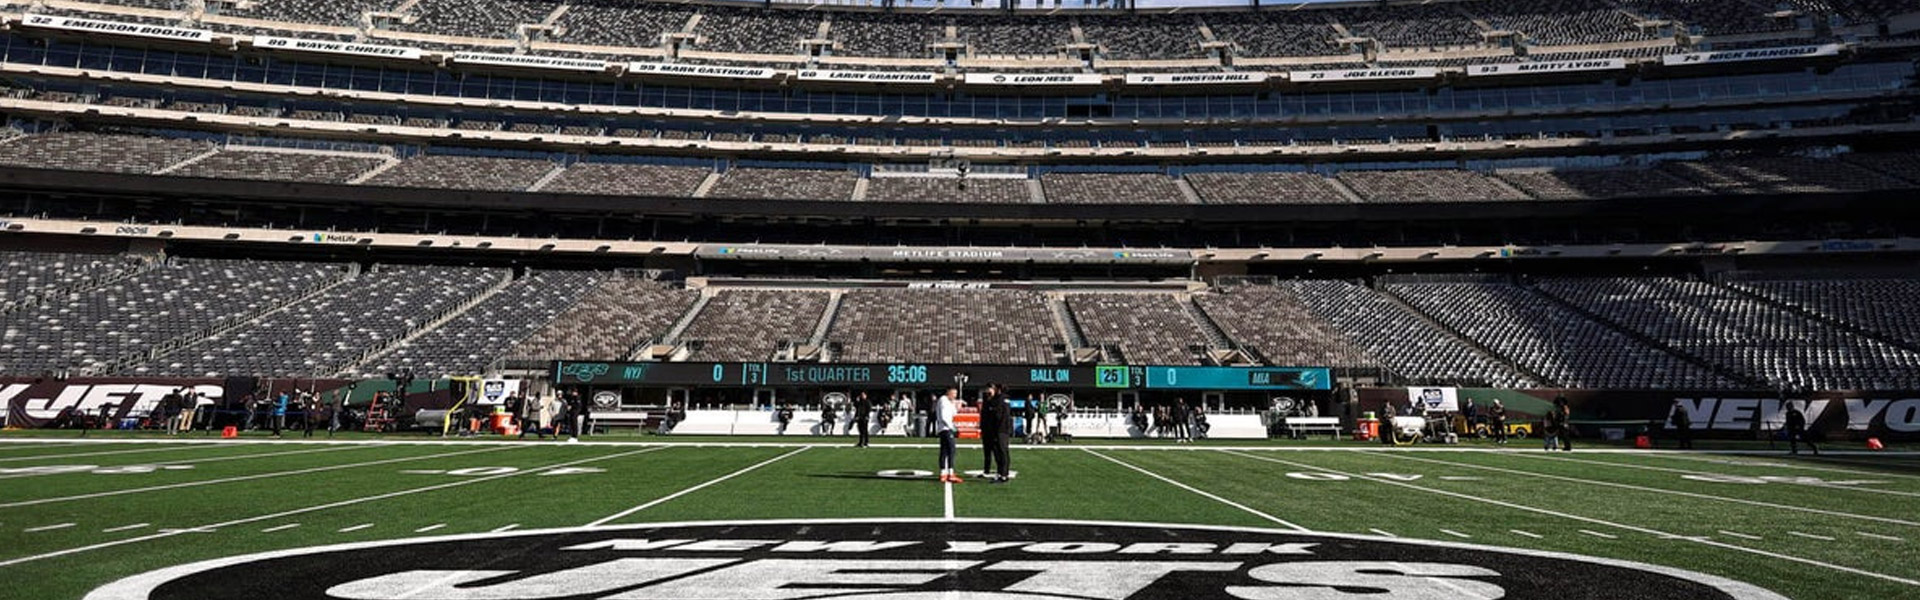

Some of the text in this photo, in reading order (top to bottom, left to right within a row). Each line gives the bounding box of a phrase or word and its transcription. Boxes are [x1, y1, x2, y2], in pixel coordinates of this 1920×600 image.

[30, 16, 202, 38] 32 EMERSON BOOZER
[296, 41, 343, 51] WAYNE
[345, 45, 407, 56] CHREBET
[1708, 51, 1745, 61] NICK
[1745, 47, 1819, 58] MANGOLD
[551, 60, 605, 68] FERGUSON
[660, 65, 697, 73] MARK
[698, 67, 764, 76] GASTINEAU
[1518, 63, 1566, 71] MARTY
[1567, 60, 1611, 69] LYONS
[868, 73, 932, 81] GRANTHAM
[1343, 71, 1369, 79] JOE
[115, 226, 149, 235] pepsi
[326, 234, 357, 242] MetLife
[623, 366, 642, 379] NYJ
[712, 364, 724, 382] 0
[750, 372, 758, 383] 3
[785, 367, 870, 382] 1st QUARTER
[887, 365, 927, 382] 35:06
[1030, 369, 1070, 382] BALL ON
[1103, 369, 1119, 383] 25
[1167, 368, 1176, 385] 0
[1252, 372, 1271, 385] MIA
[1134, 375, 1141, 386] 3
[1663, 398, 1830, 431] NEW
[558, 538, 1323, 555] NEW YORK
[324, 556, 1507, 600] JETS
